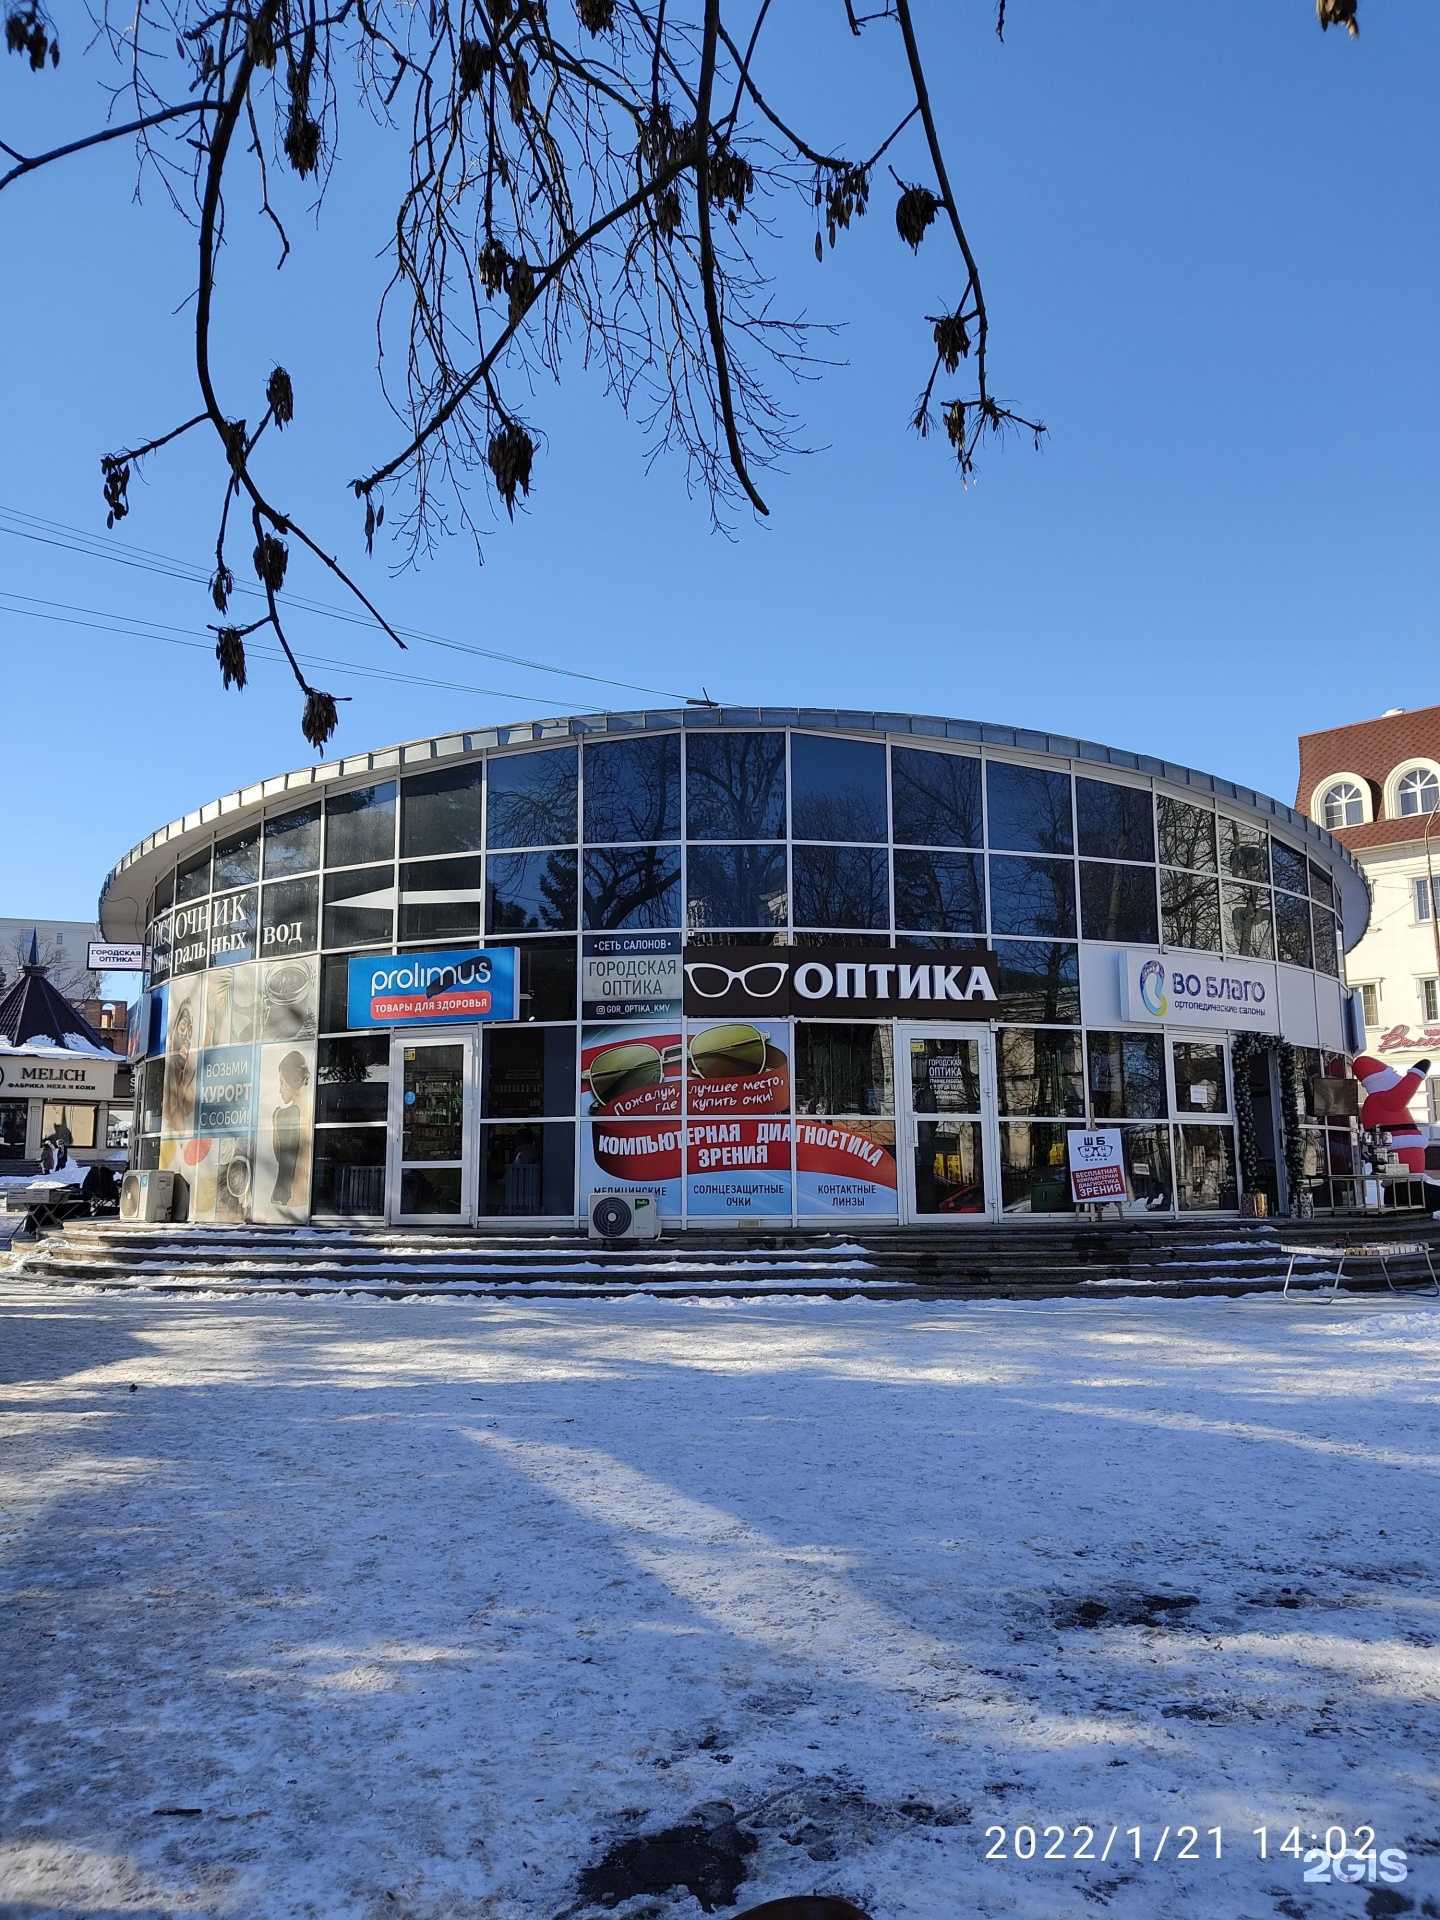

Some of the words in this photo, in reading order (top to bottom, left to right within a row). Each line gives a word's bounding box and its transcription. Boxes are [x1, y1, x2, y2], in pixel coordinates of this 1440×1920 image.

[263, 922, 303, 945] вод
[91, 949, 141, 957] ГОРОДСКАЯ
[598, 941, 621, 951] СЕТЬ
[623, 940, 667, 950] САЛОНОВ
[589, 960, 676, 978] ГОРОДСКАЯ
[371, 962, 491, 997] prolimus
[793, 962, 999, 1001] ОПТИКА
[1172, 972, 1201, 997] ВО
[602, 980, 662, 996] ОПТИКА
[375, 1003, 413, 1013] ТОВАРЫ
[414, 1001, 435, 1013] ДЛЯ
[436, 998, 488, 1011] ЗДОРОВЬЯ
[1174, 1000, 1238, 1014] ортопедические
[1238, 1006, 1266, 1016] салоны
[206, 1061, 248, 1078] ВОЗЬМИ
[928, 1059, 962, 1067] ГОРОДСКАЯ
[21, 1067, 86, 1082] MELICH
[928, 1067, 962, 1077] ОПТИКА
[200, 1083, 253, 1104] КУРОРТ
[613, 1085, 680, 1116] Пожалуй,
[688, 1083, 738, 1098] лучшее
[743, 1076, 784, 1090] место,
[655, 1100, 678, 1113] где
[692, 1097, 737, 1111] купить
[742, 1089, 774, 1105] очки!
[200, 1112, 208, 1126] С
[598, 1123, 741, 1156] КОМПЬЮТЕРНАЯ
[756, 1123, 884, 1168] ДИАГНОСТИКА
[698, 1145, 768, 1168] ЗРЕНИЯ
[1075, 1167, 1118, 1179] БЕСПЛАТНАЯ
[693, 1184, 785, 1196] СОЛНЦЕЗАЩИТНЫЕ
[817, 1184, 877, 1195] КОНТАКТНЫЕ
[1078, 1179, 1120, 1189] ДИАГНОСТИКА
[1080, 1184, 1122, 1197] ЗРЕНИЯ
[726, 1197, 751, 1207] ОЧКИ
[831, 1197, 865, 1207] ЛИНЗЫ
